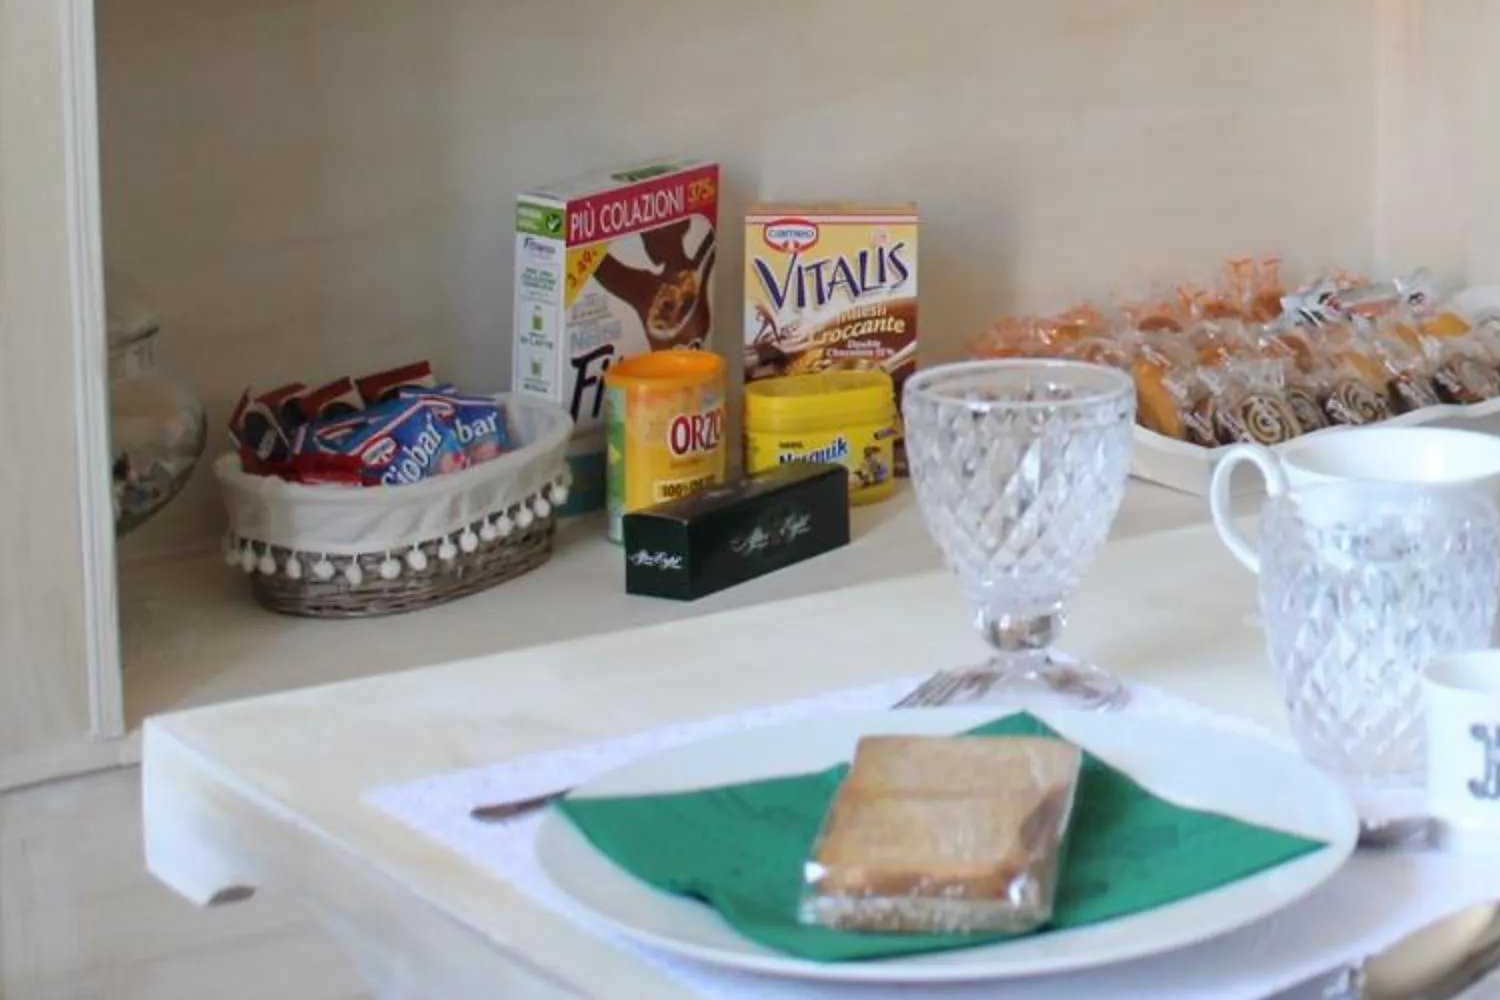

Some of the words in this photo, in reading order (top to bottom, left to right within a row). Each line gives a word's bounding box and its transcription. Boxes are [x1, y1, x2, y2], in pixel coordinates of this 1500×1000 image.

[571, 201, 595, 241] PIÙ
[600, 184, 685, 234] COLAZIONI
[754, 242, 909, 309] VITALIS
